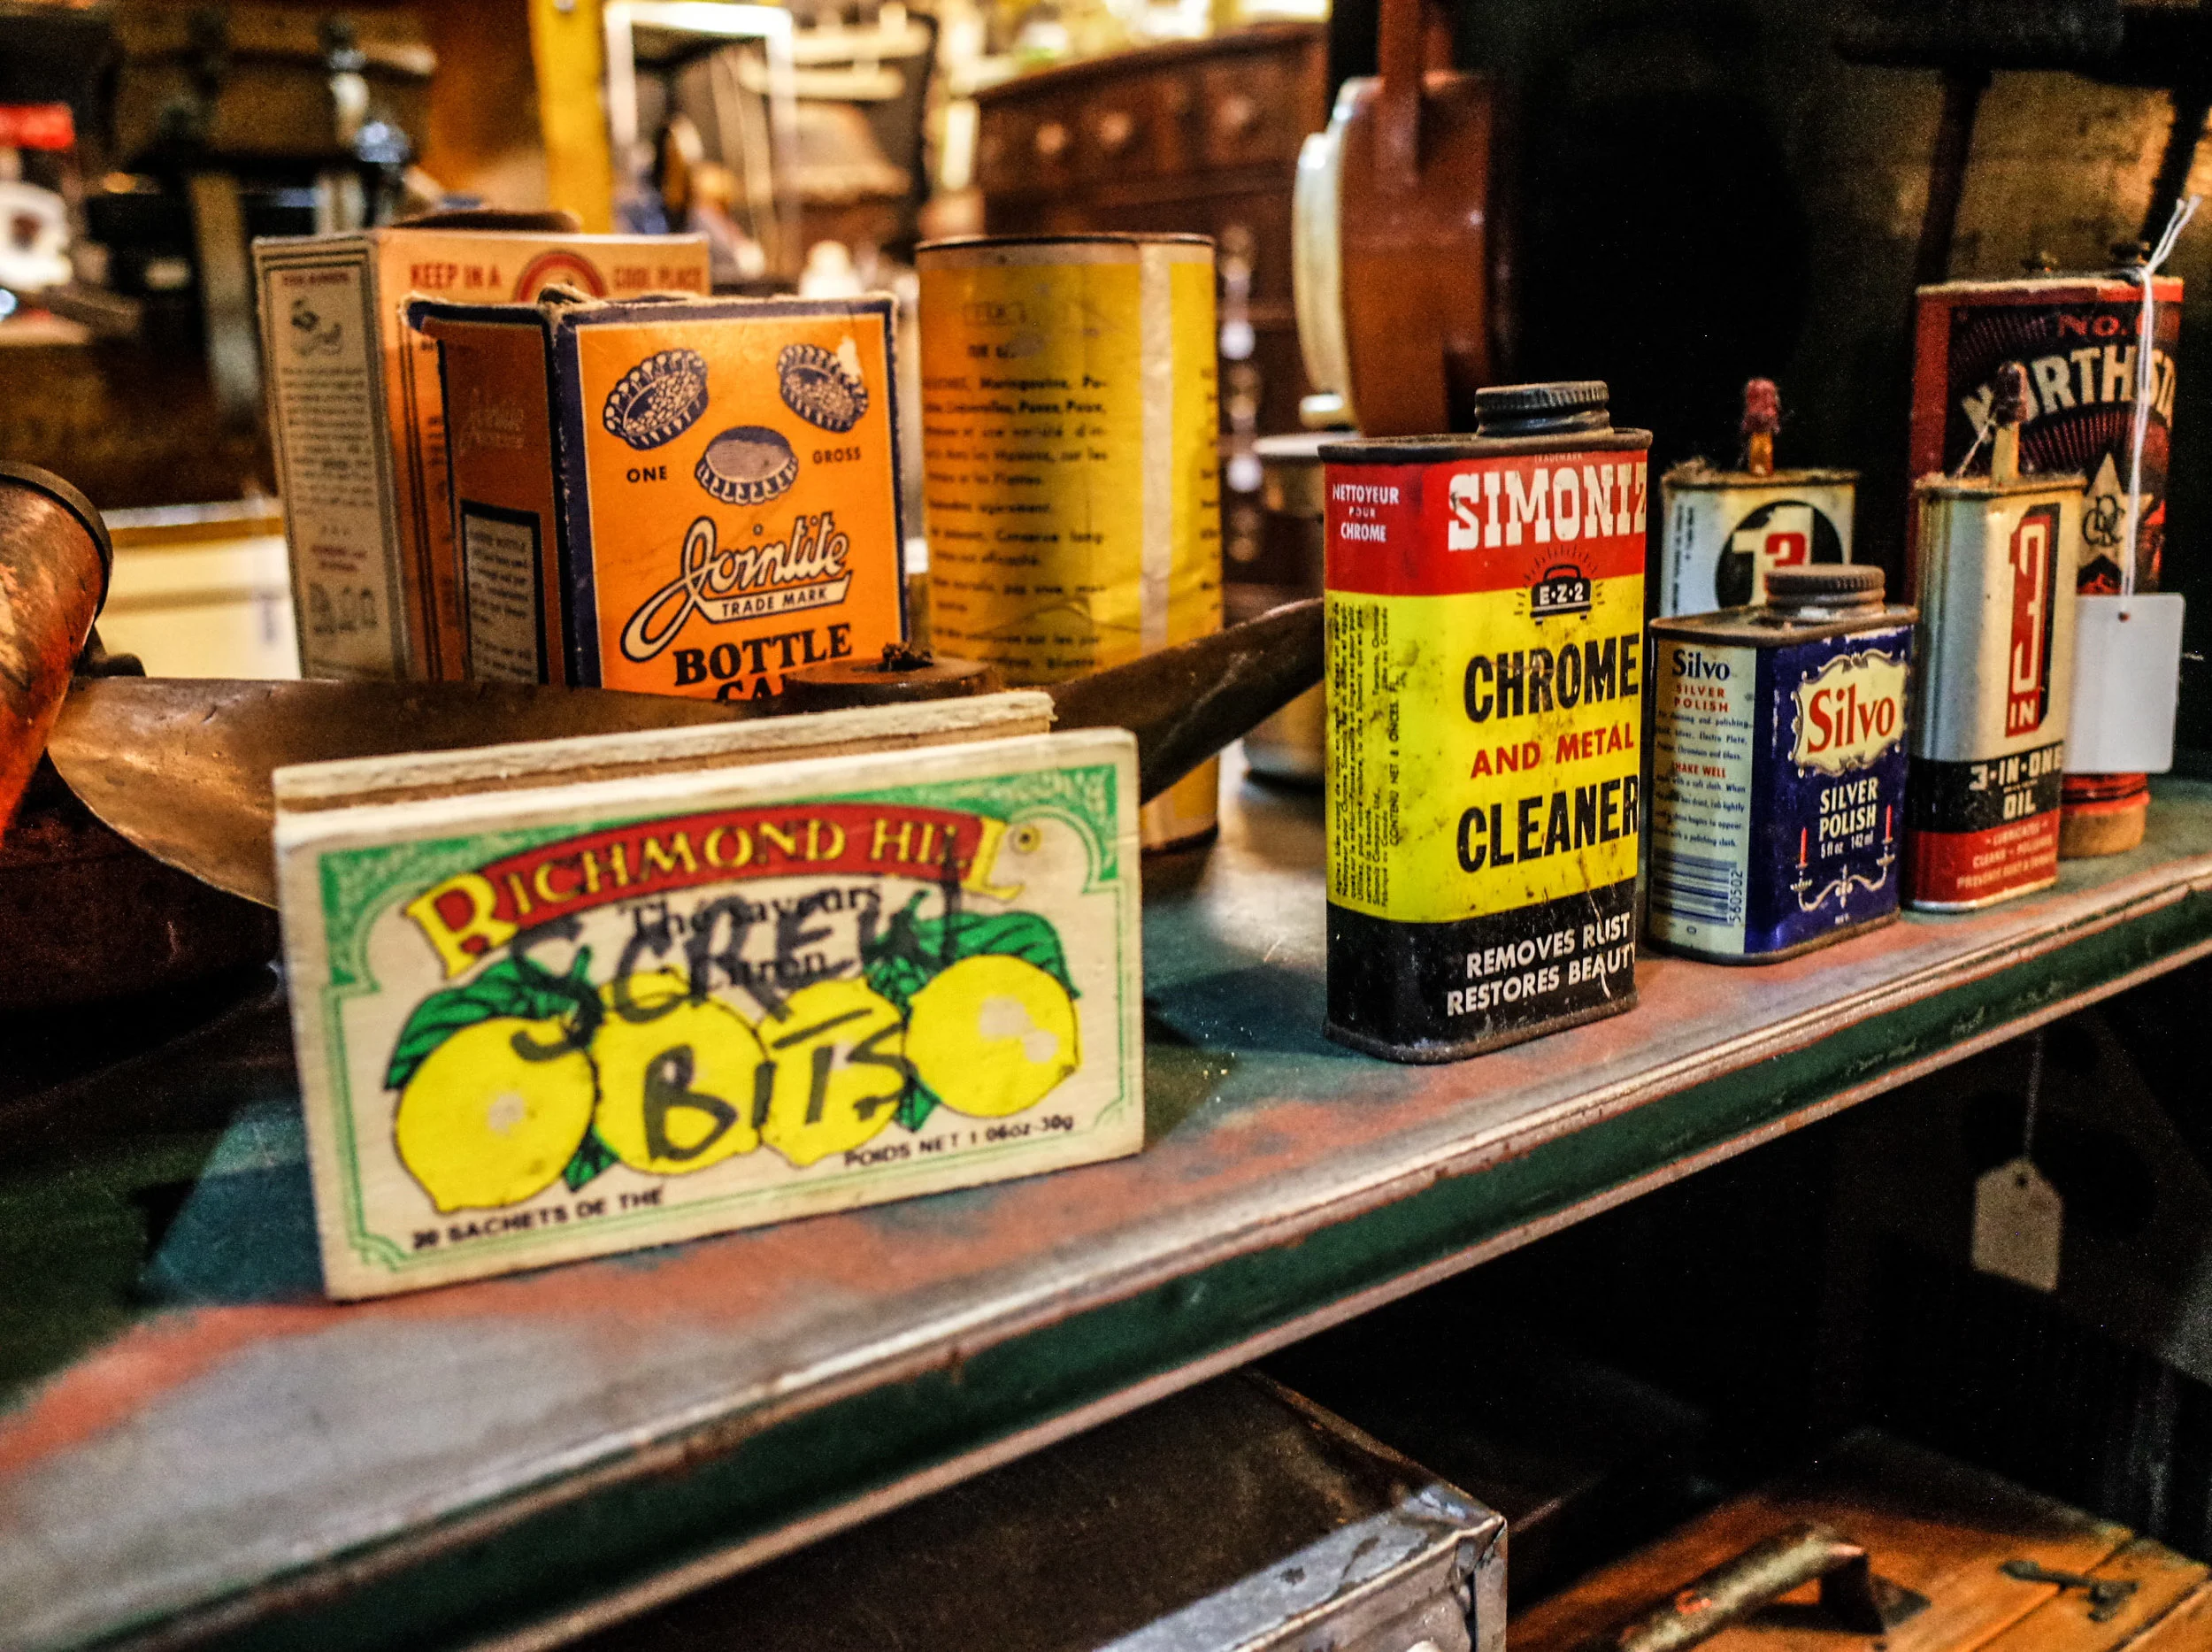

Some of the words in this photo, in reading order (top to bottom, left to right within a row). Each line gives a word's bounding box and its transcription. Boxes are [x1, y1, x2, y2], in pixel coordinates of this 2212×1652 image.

[410, 263, 458, 289] KEEP
[811, 446, 861, 465] GROSS
[626, 465, 668, 483] ONE
[1333, 484, 1400, 505] NETTOYEUR
[1348, 506, 1377, 519] POUR
[1340, 522, 1387, 543] CHROME
[721, 595, 776, 618] TRADE
[782, 587, 827, 607] MARK
[672, 623, 852, 687] BOTTLE
[1671, 649, 1730, 680] Silvo
[1463, 633, 1640, 724] CHROME
[1676, 684, 1725, 698] SILVER
[1673, 696, 1729, 712] POLISH
[1806, 683, 1896, 755] Silvo
[2009, 698, 2037, 731] IN
[1470, 741, 1541, 780] AND
[1555, 722, 1634, 765] METAL
[1389, 764, 1399, 785] NET
[1702, 765, 1727, 779] WELL
[1819, 777, 1879, 815] SILVER
[2003, 789, 2037, 820] OIL
[1389, 790, 1400, 847] CONTENU
[1456, 774, 1639, 874] CLEANER
[1818, 803, 1877, 841] POLISH
[406, 816, 847, 979] RICHMOND
[1729, 870, 1743, 924] 560502
[1466, 928, 1575, 979] REMOVES
[1582, 912, 1631, 948] RUST
[1447, 967, 1560, 1017] RESTORES
[644, 1007, 917, 1161] BITS
[844, 1142, 911, 1168] POIDS
[919, 1132, 959, 1152] NET
[448, 1203, 571, 1243] SACHETS
